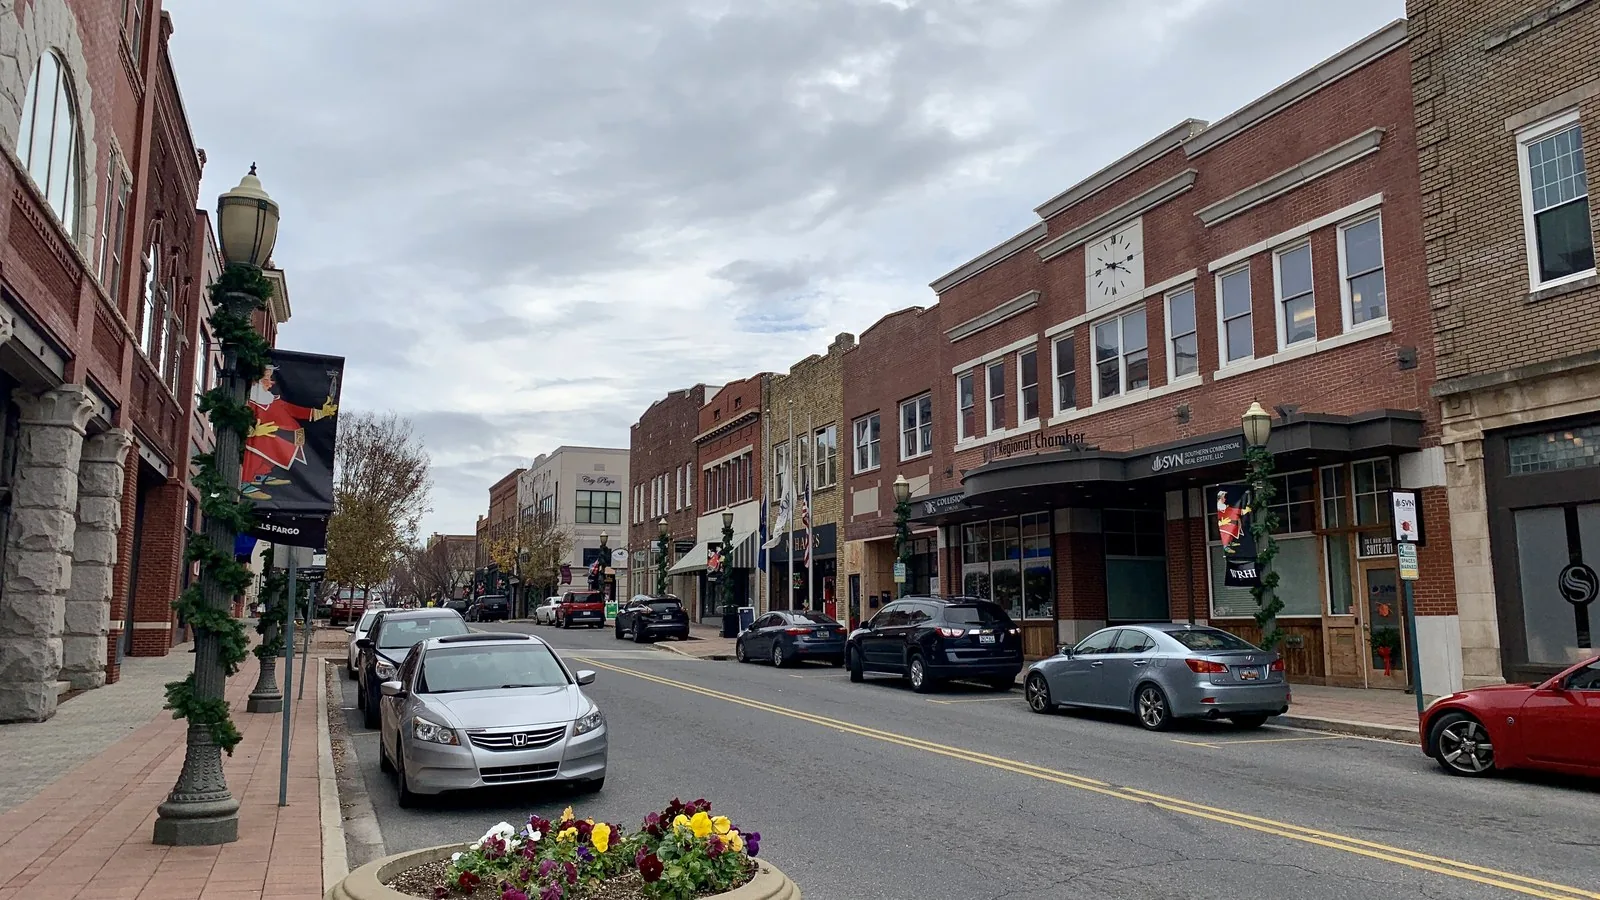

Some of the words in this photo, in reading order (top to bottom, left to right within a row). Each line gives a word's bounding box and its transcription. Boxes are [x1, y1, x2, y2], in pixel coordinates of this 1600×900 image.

[1035, 428, 1086, 448] Chamber
[1184, 447, 1209, 459] SOUTHERN
[1209, 442, 1240, 454] COMMERCIAL
[1163, 452, 1184, 469] SVN
[1184, 457, 1197, 465] REAL
[1214, 452, 1224, 461] LLC
[1402, 499, 1414, 507] SVN
[272, 525, 300, 535] FARGO
[1367, 544, 1382, 555] SUITE
[1383, 543, 1393, 554] 201
[1230, 568, 1257, 579] WRHI
